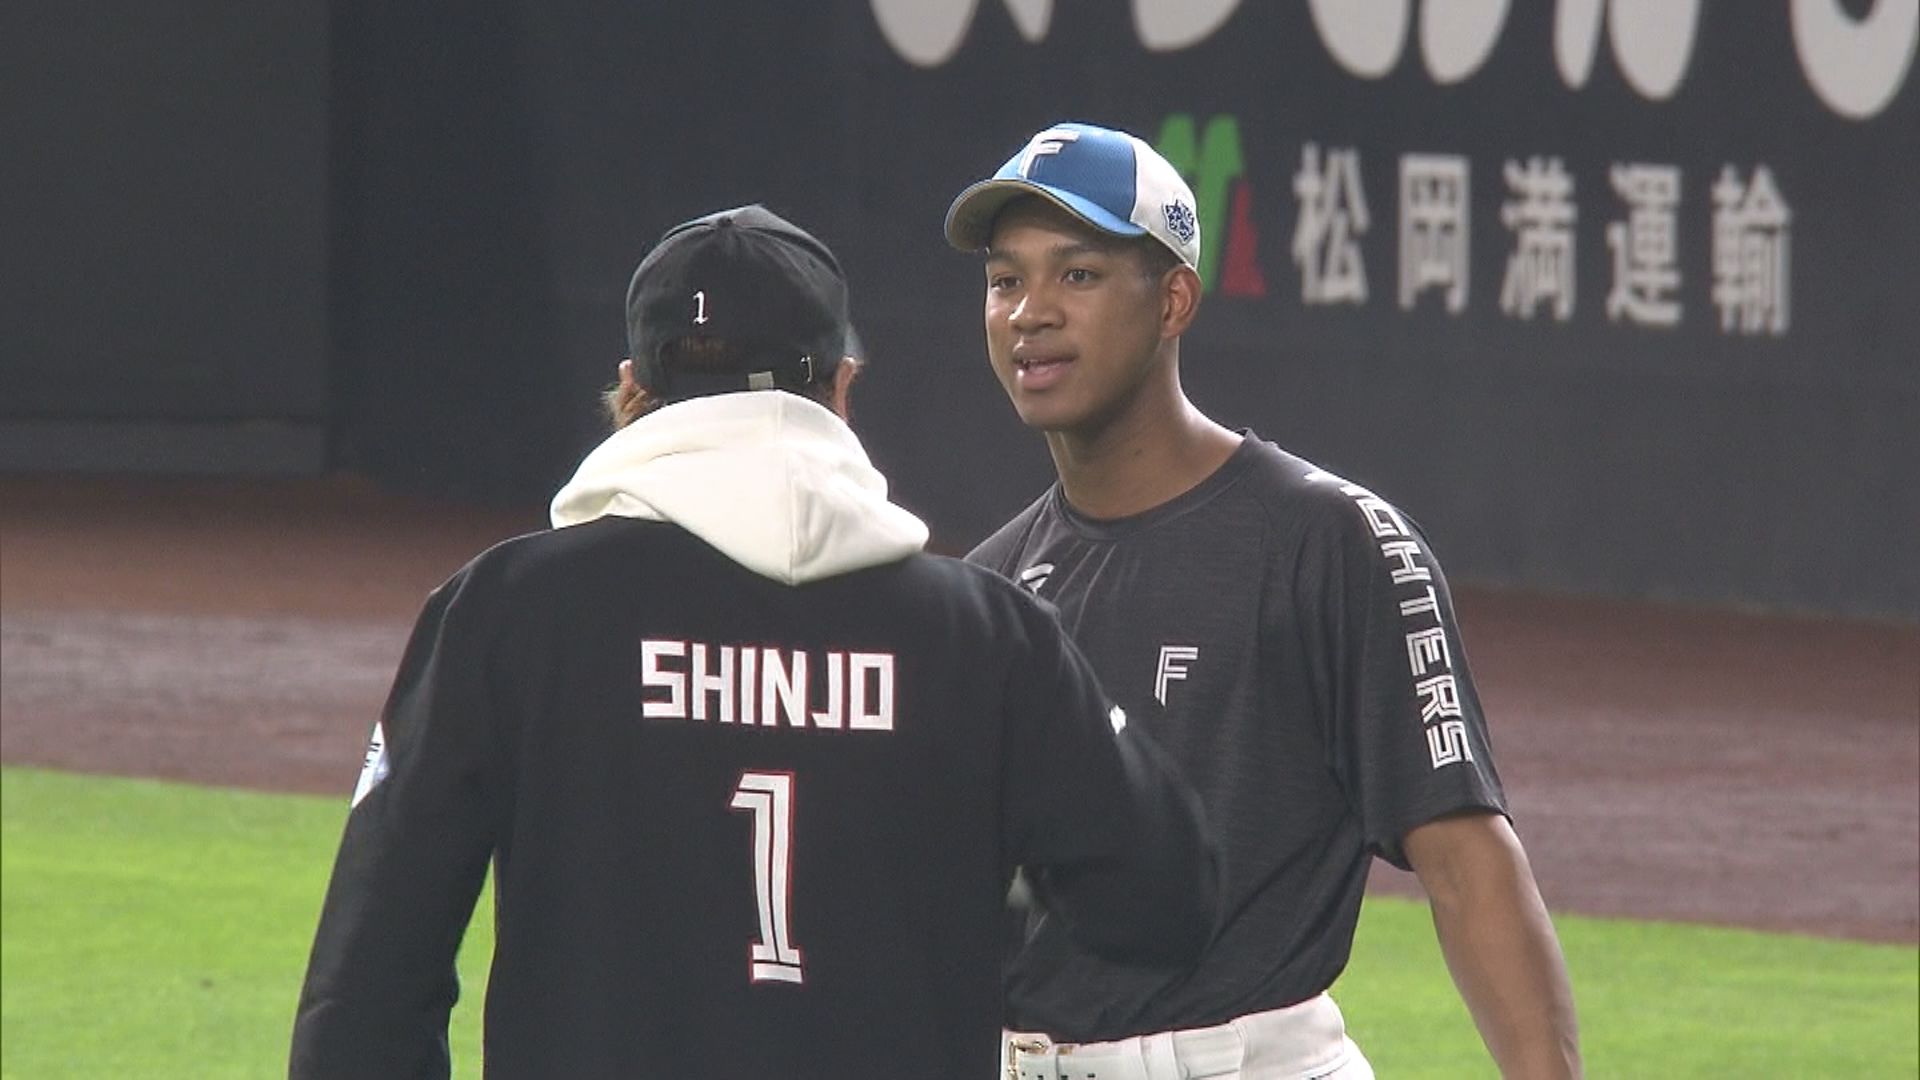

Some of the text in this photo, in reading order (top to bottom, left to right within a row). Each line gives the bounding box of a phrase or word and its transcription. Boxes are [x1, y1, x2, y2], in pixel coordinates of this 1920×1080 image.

[1017, 128, 1081, 179] F
[1293, 143, 1793, 335] 松岡満運輸
[693, 290, 708, 325] 1
[1304, 470, 1473, 770] GHTERS
[640, 638, 896, 731] SHINJO
[1154, 645, 1199, 707] F
[729, 770, 804, 984] 1
